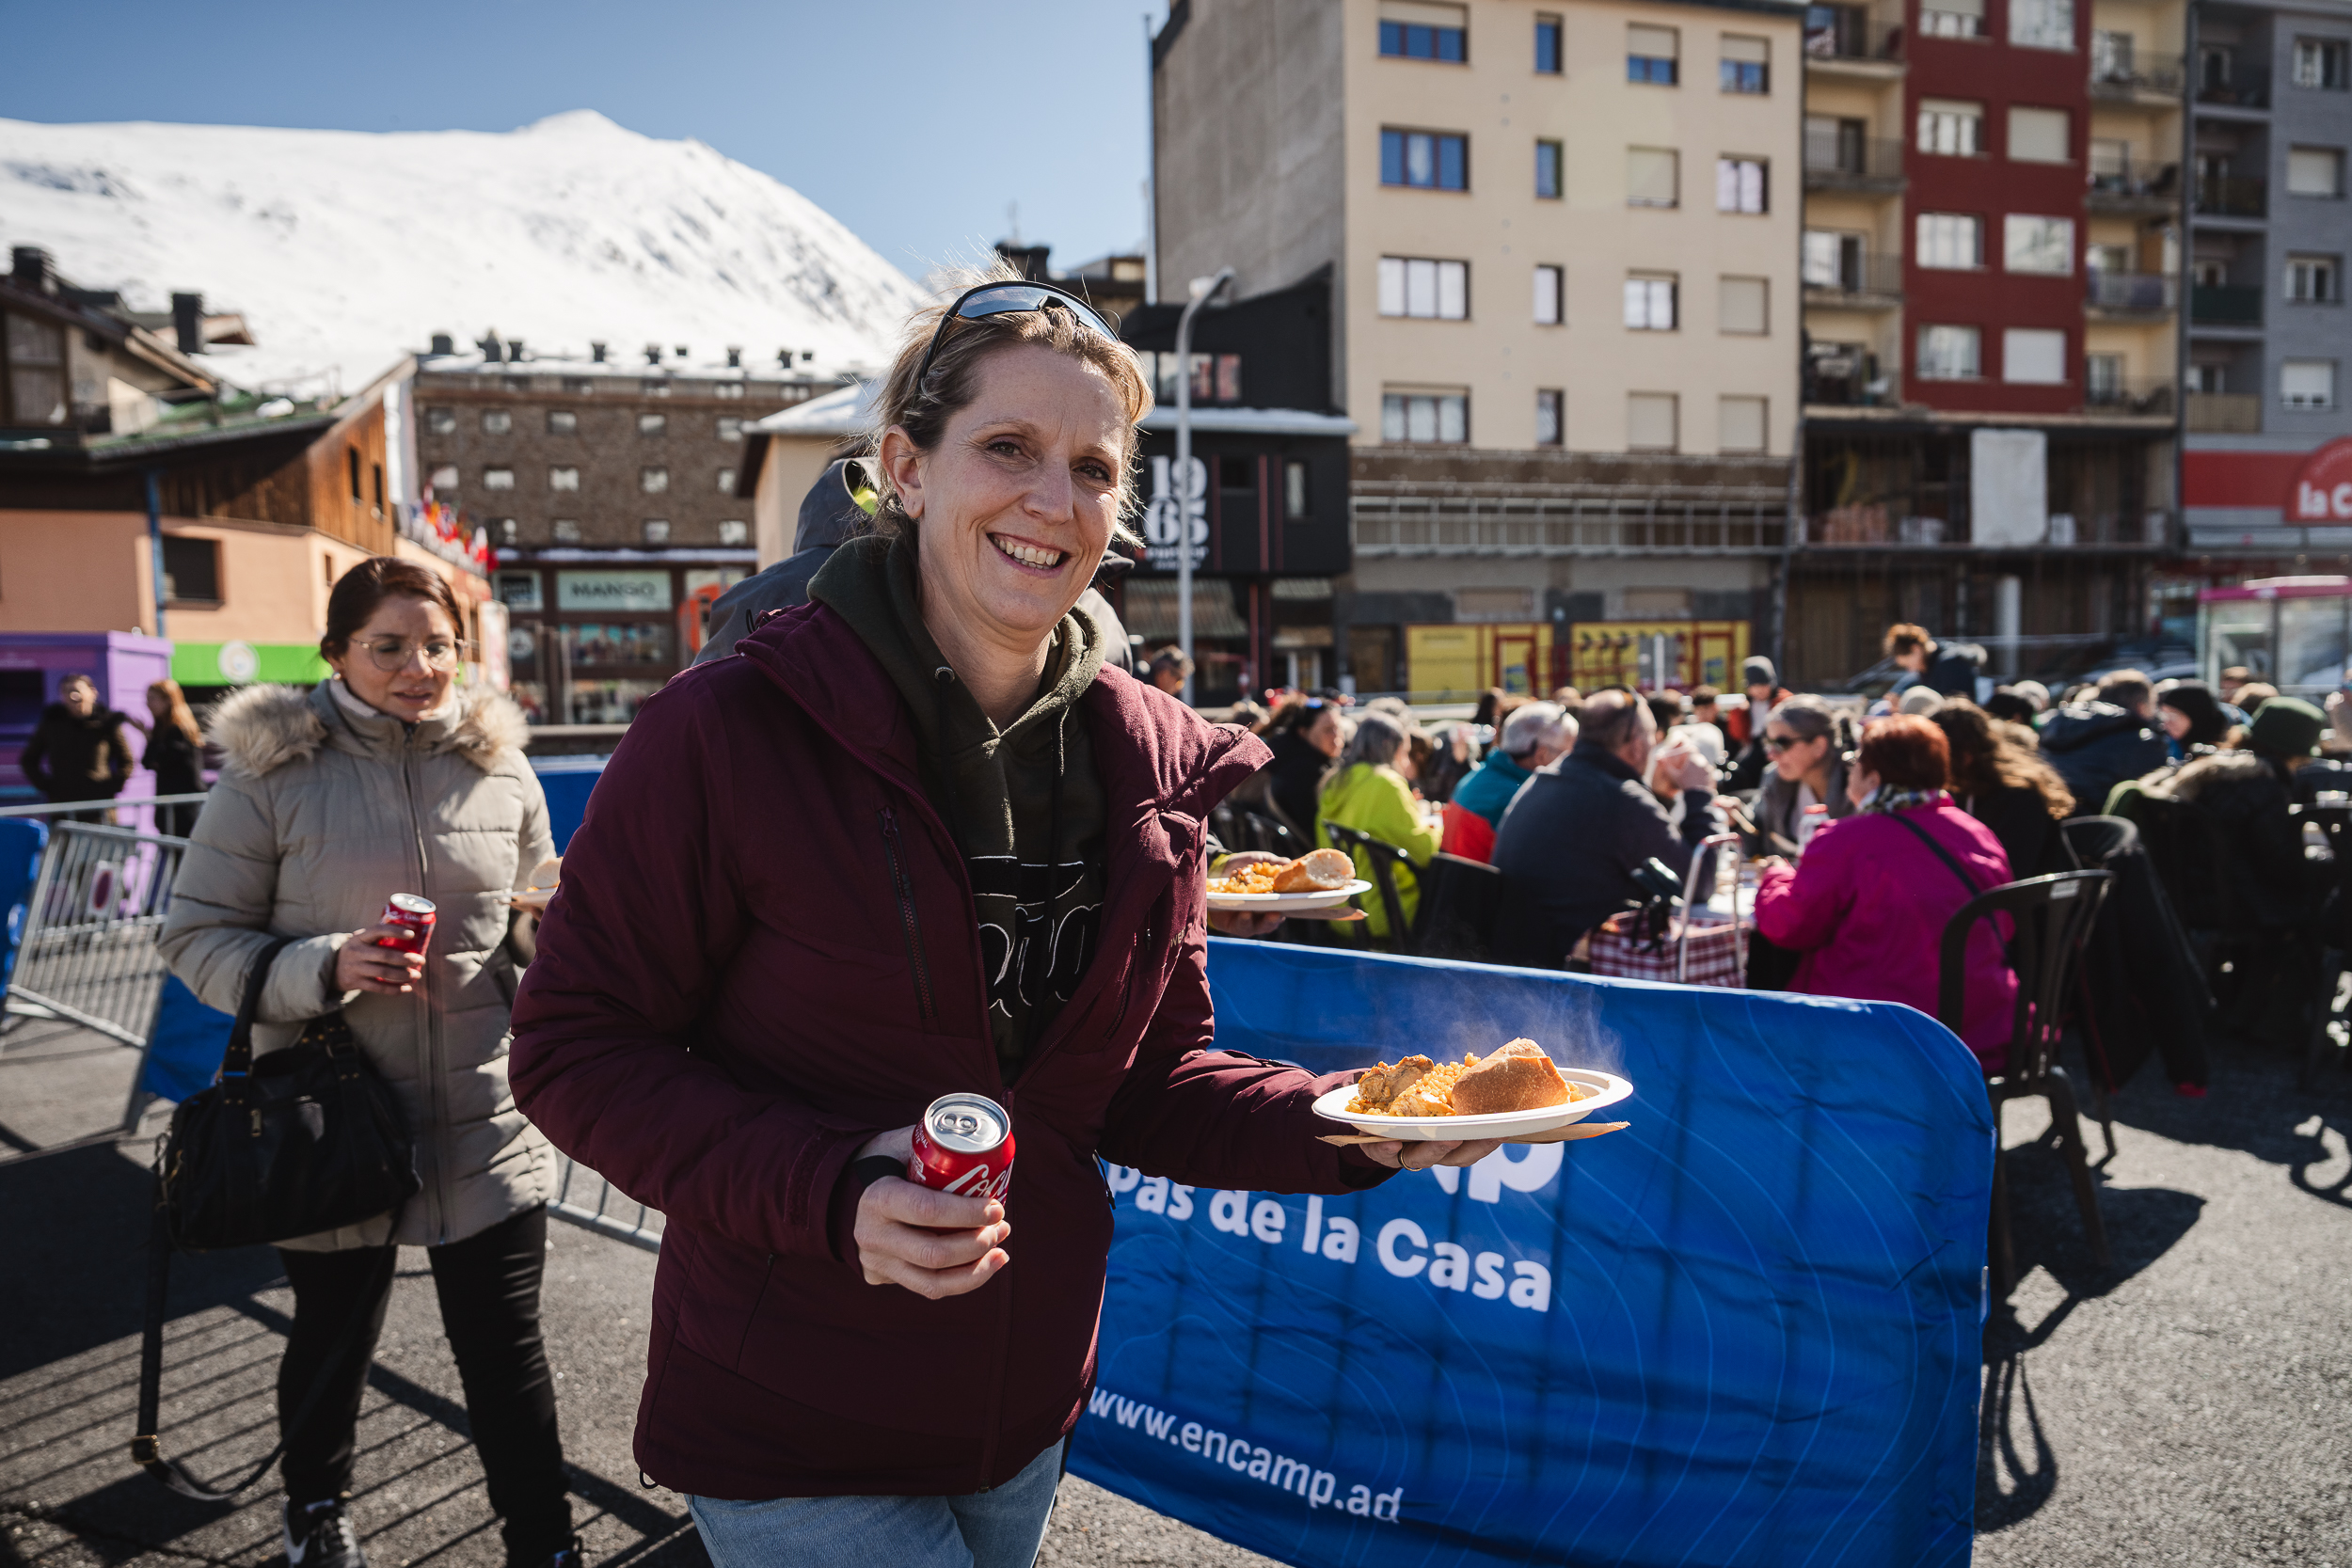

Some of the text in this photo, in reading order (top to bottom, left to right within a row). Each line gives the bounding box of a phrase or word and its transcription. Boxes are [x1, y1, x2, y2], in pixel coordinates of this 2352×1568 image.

[571, 580, 657, 597] MANGO
[1209, 1190, 1286, 1244] de
[1302, 1195, 1360, 1264] la
[1376, 1217, 1552, 1313] Casa
[1089, 1386, 1404, 1524] www.encamp.ad
